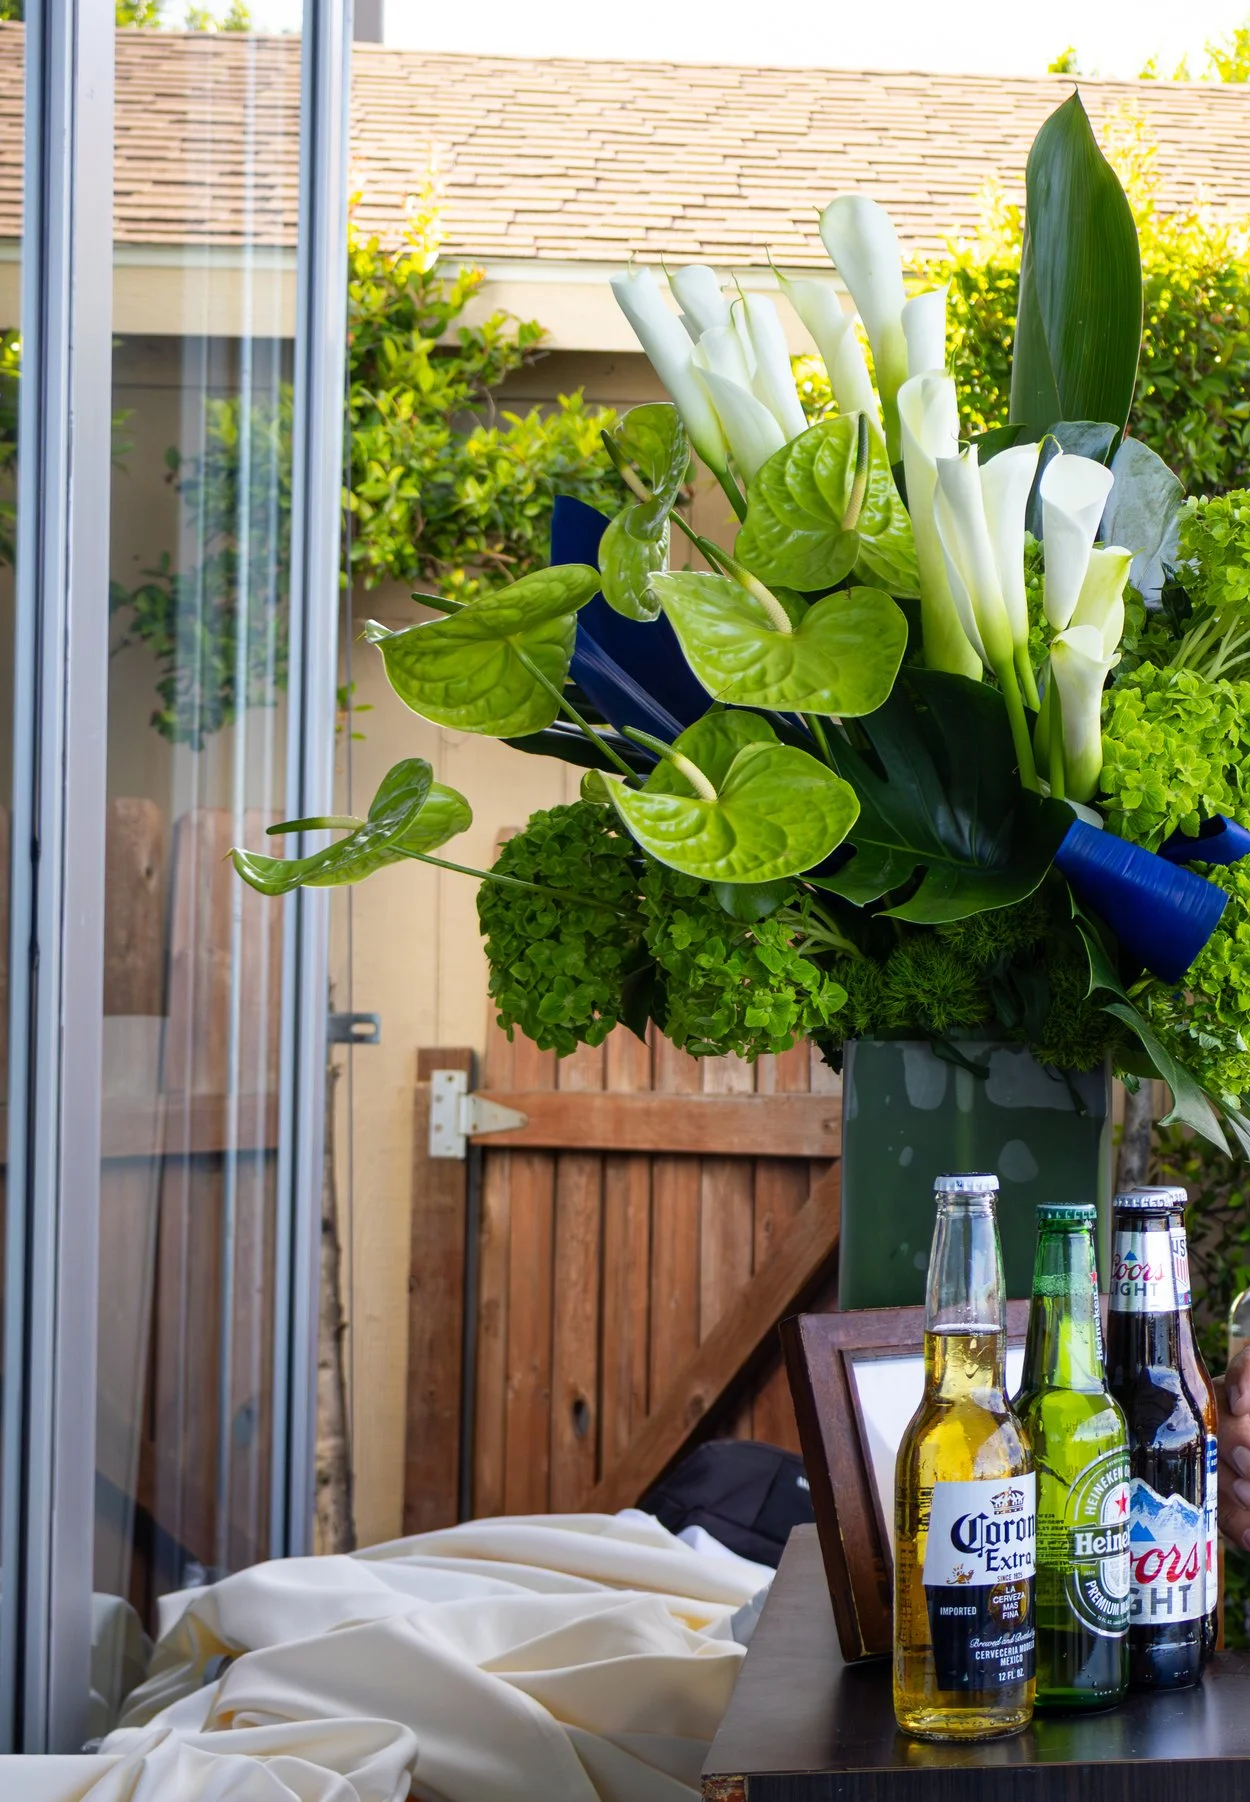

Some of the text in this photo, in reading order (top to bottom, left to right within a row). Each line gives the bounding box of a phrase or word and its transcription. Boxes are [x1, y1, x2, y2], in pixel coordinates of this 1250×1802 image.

[1111, 1281, 1158, 1297] IGHT
[1084, 1463, 1124, 1516] HEINEKEN
[950, 1512, 1035, 1558] Coron
[1074, 1525, 1130, 1556] Heine
[985, 1547, 1032, 1572] Extra
[1130, 1541, 1201, 1584] ors
[1005, 1585, 1016, 1594] LA
[1085, 1580, 1120, 1615] PREMIUM
[992, 1592, 1026, 1604] CERVEZA
[1130, 1583, 1192, 1617] GHT
[940, 1606, 977, 1616] IMPORTED
[1002, 1610, 1019, 1620] FINA
[975, 1646, 1019, 1660] CERVECERIA
[1000, 1653, 1024, 1667] MEXICO
[998, 1672, 1007, 1682] 12
